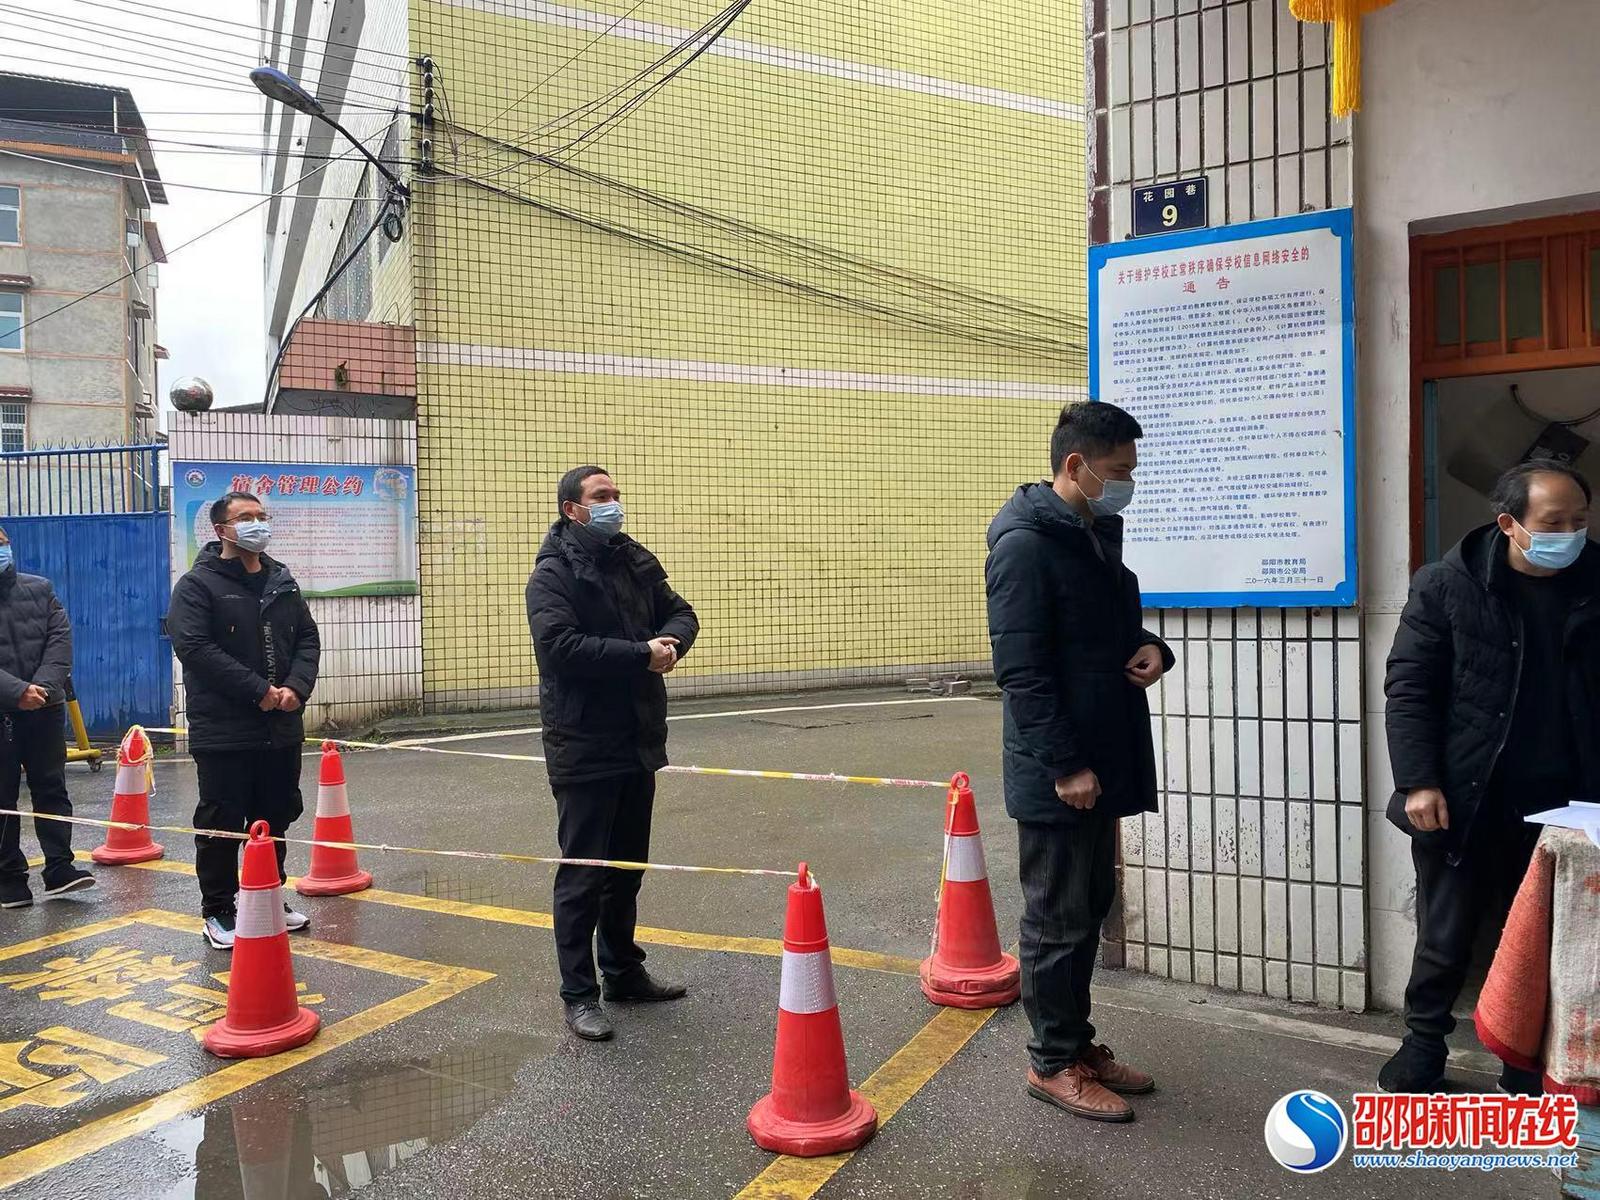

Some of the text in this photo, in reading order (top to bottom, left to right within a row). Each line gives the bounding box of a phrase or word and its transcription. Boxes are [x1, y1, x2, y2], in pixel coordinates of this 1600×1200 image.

[1143, 184, 1197, 203] 花园巷
[1162, 204, 1178, 227] 9
[1118, 245, 1309, 286] 关于维护学校正常秩序确保学校信息网络安全的
[1182, 275, 1230, 295] 通告
[232, 474, 364, 496] 宿舍管理公约
[1261, 558, 1306, 566] 邵阳市教育局
[1261, 567, 1306, 575] 邵阳市公安局
